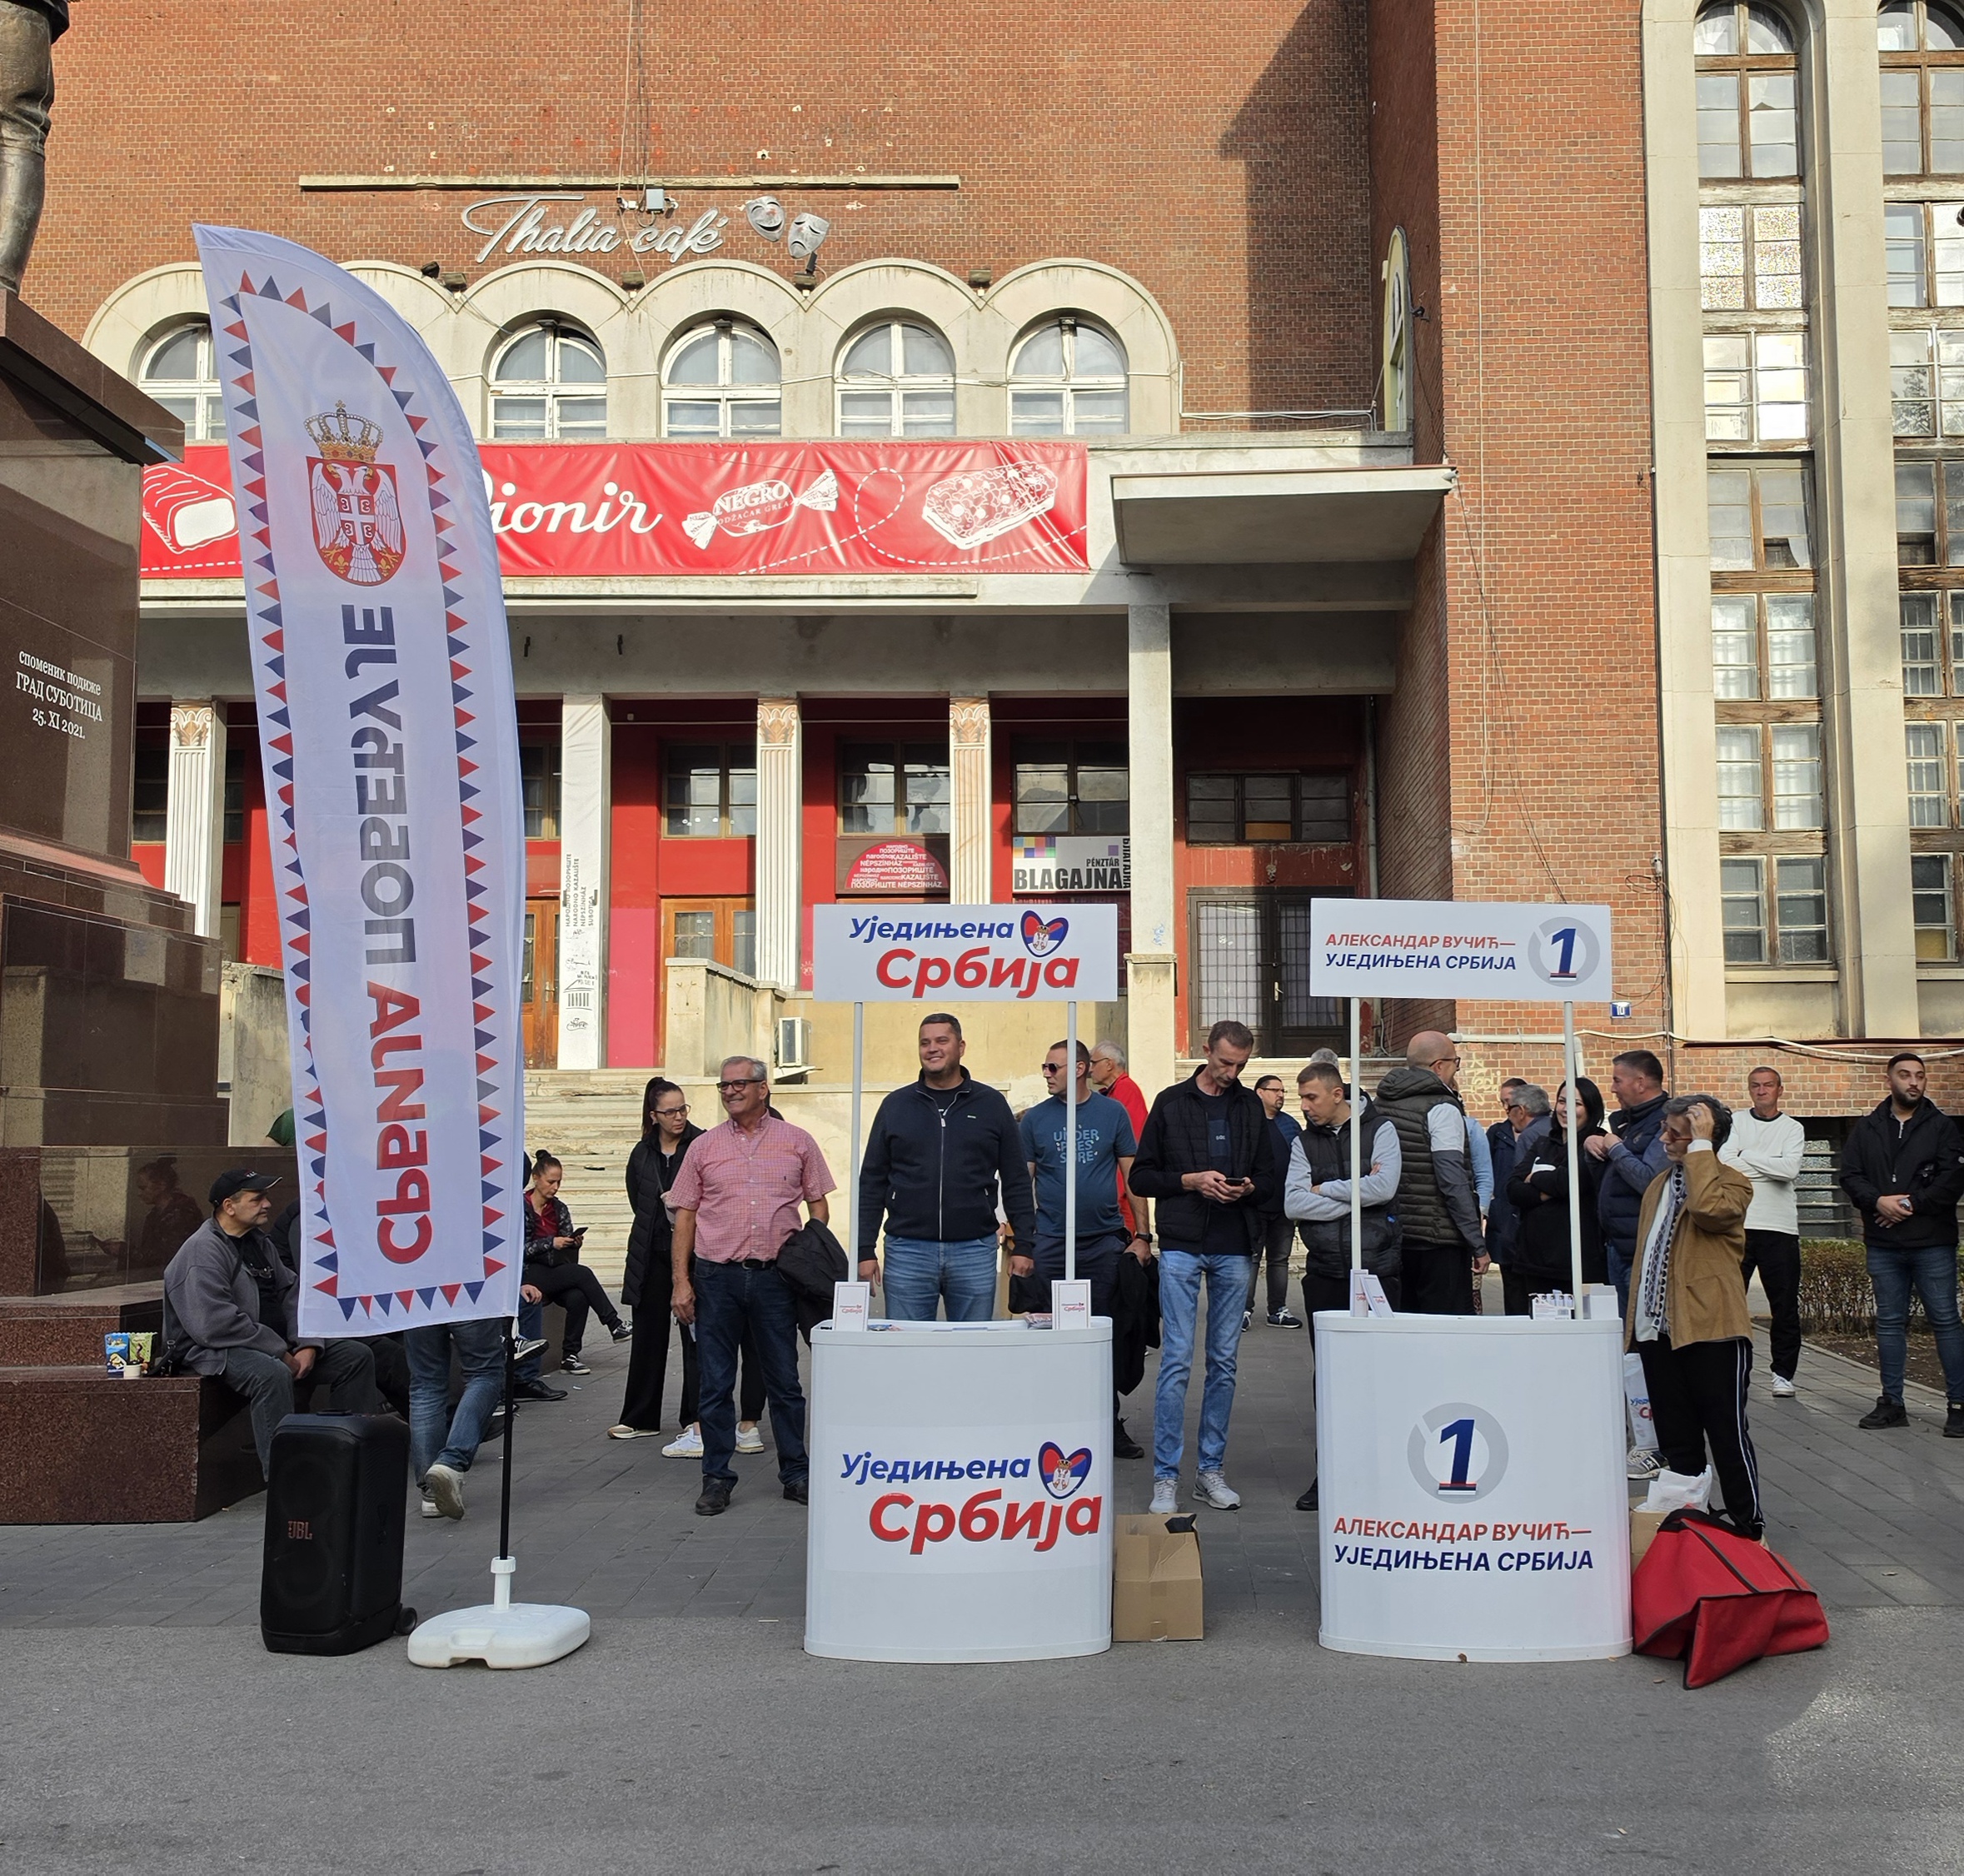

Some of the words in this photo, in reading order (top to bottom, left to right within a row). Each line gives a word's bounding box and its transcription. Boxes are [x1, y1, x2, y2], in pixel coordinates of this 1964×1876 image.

[461, 193, 621, 263] Thalia
[631, 207, 730, 263] café
[713, 481, 790, 516] NEGRO
[19, 651, 66, 682] споменик
[67, 671, 102, 696] подиже
[16, 671, 45, 701] ГРАД
[46, 685, 102, 722] СУБОТИЦА
[32, 707, 47, 727] 25.
[48, 711, 61, 730] XI
[62, 719, 86, 740] 2021.
[1085, 857, 1119, 867] PÉNZTÁR
[1014, 868, 1123, 891] BLAGAJNA
[849, 916, 1014, 943] Уједињена
[1325, 934, 1440, 950] АЛЕКСАНДАР
[876, 946, 1079, 999] Србија
[1325, 953, 1441, 970] УЈЕДИЊЕНА
[1445, 955, 1516, 970] СРБИЈА
[1059, 1150, 1094, 1163] SRE
[1061, 1140, 1093, 1151] PES
[840, 1451, 1031, 1485] Уједињена
[287, 1520, 313, 1540] JBL
[869, 1488, 1102, 1555] Србија
[1333, 1517, 1488, 1544] АЛЕКСАНДАР
[1334, 1544, 1490, 1572] УЈЕДИЊЕНА
[1497, 1550, 1593, 1571] СРБИЈА
